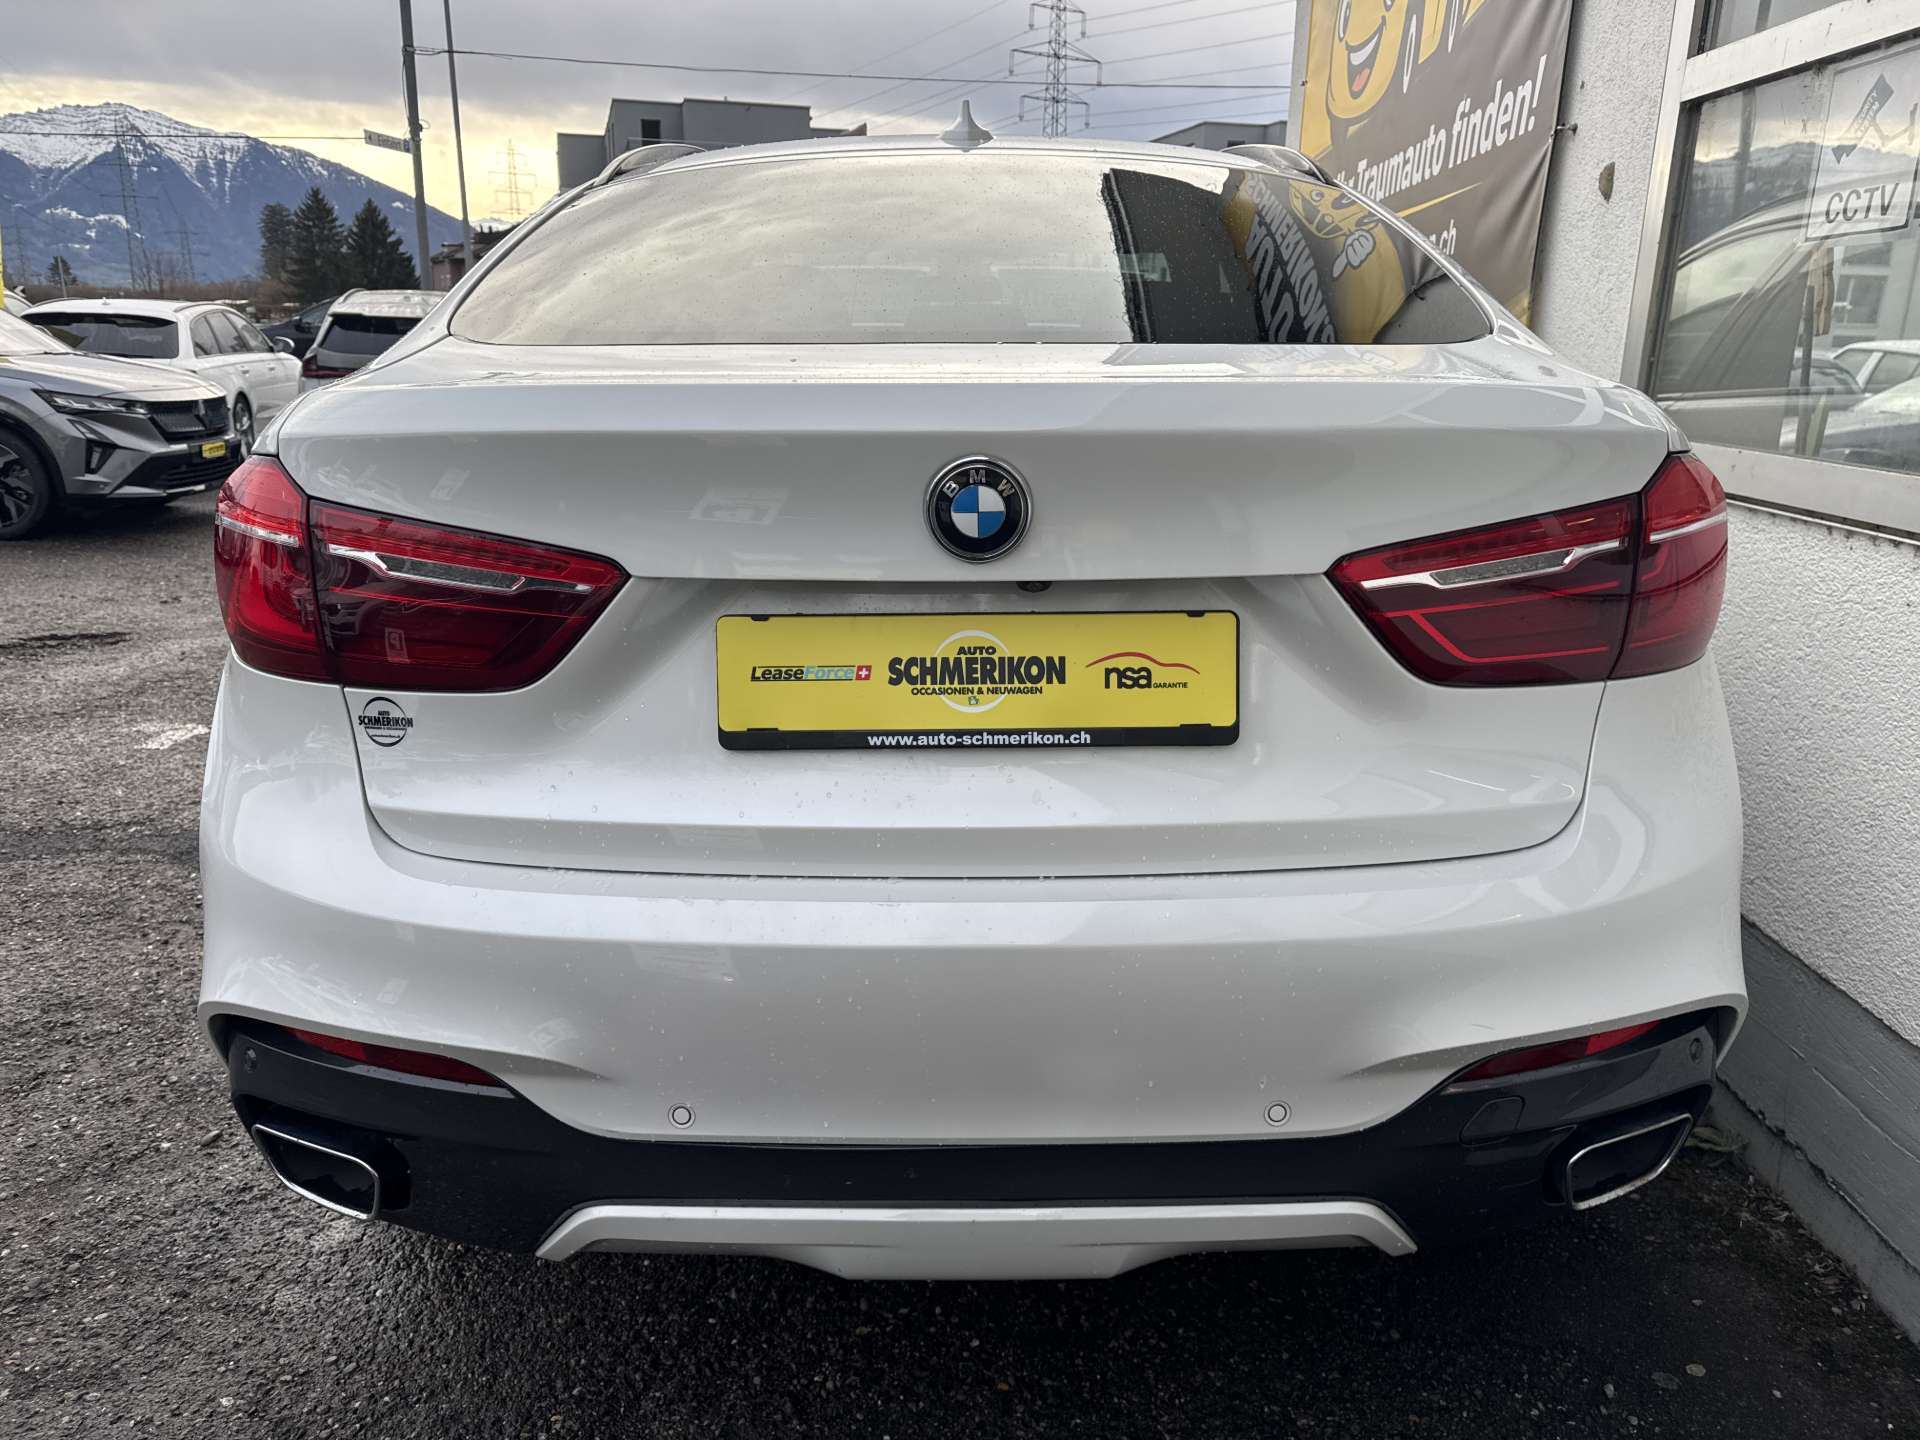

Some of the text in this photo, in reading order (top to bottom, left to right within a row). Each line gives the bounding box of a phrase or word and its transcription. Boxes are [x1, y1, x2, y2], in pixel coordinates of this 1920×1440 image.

[1356, 54, 1548, 202] Traumauto finden!
[1824, 182, 1900, 225] CCTV
[942, 469, 1016, 499] BMW
[956, 646, 997, 656] AUTO
[751, 665, 856, 681] LeaseForce
[888, 656, 1067, 686] SCHMERIKON
[1104, 667, 1152, 689] nsa
[911, 686, 1043, 696] OCCASIONEN & NEUWAGEN
[358, 715, 414, 728] SCHMERIKON
[867, 731, 1092, 746] www.auto-schmerikon.ch
